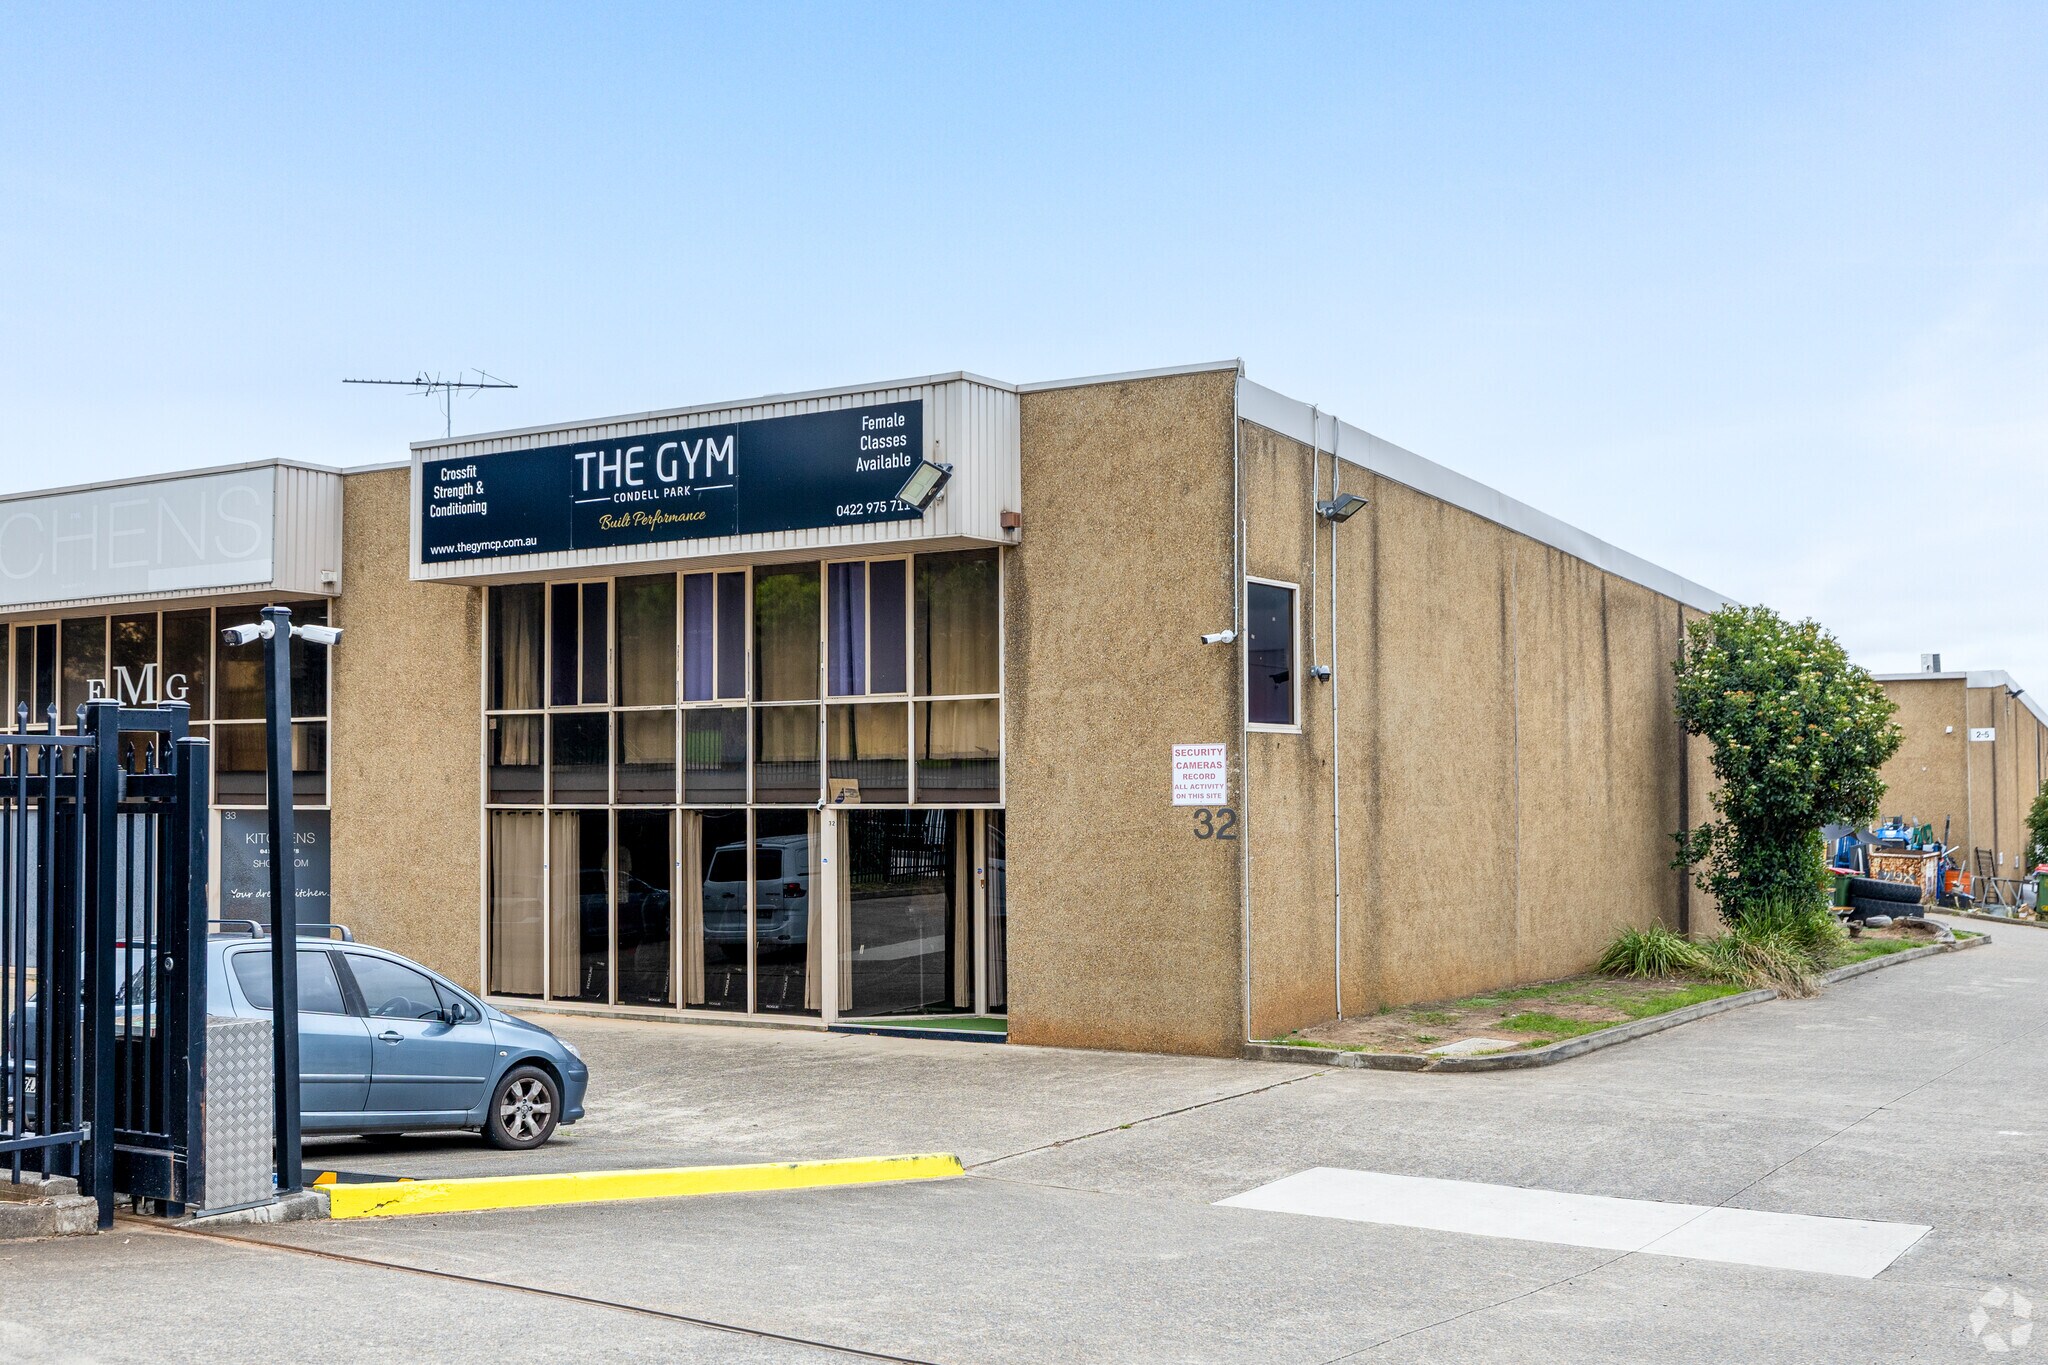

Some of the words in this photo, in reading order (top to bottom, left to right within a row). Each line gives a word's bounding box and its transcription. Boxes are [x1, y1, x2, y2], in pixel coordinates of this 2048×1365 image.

[862, 412, 905, 431] Female
[860, 434, 907, 451] Classes
[574, 445, 644, 491] THE
[656, 435, 734, 482] GYM
[856, 452, 911, 473] Available
[441, 465, 477, 481] Crossfit
[433, 482, 473, 499] Strength
[476, 480, 484, 495] &
[613, 489, 659, 503] CONDELL
[664, 485, 691, 498] PARK
[430, 500, 487, 518] Conditioning
[836, 503, 863, 517] 0422
[866, 501, 887, 514] 975
[599, 512, 631, 531] Built
[632, 509, 706, 532] Performance
[430, 537, 537, 555] www.thegymcp.com.au
[1174, 748, 1223, 757] SECURITY
[1175, 761, 1223, 770] CAMERAS
[225, 811, 237, 820] 33
[1193, 808, 1238, 839] 32
[231, 888, 253, 898] Your
